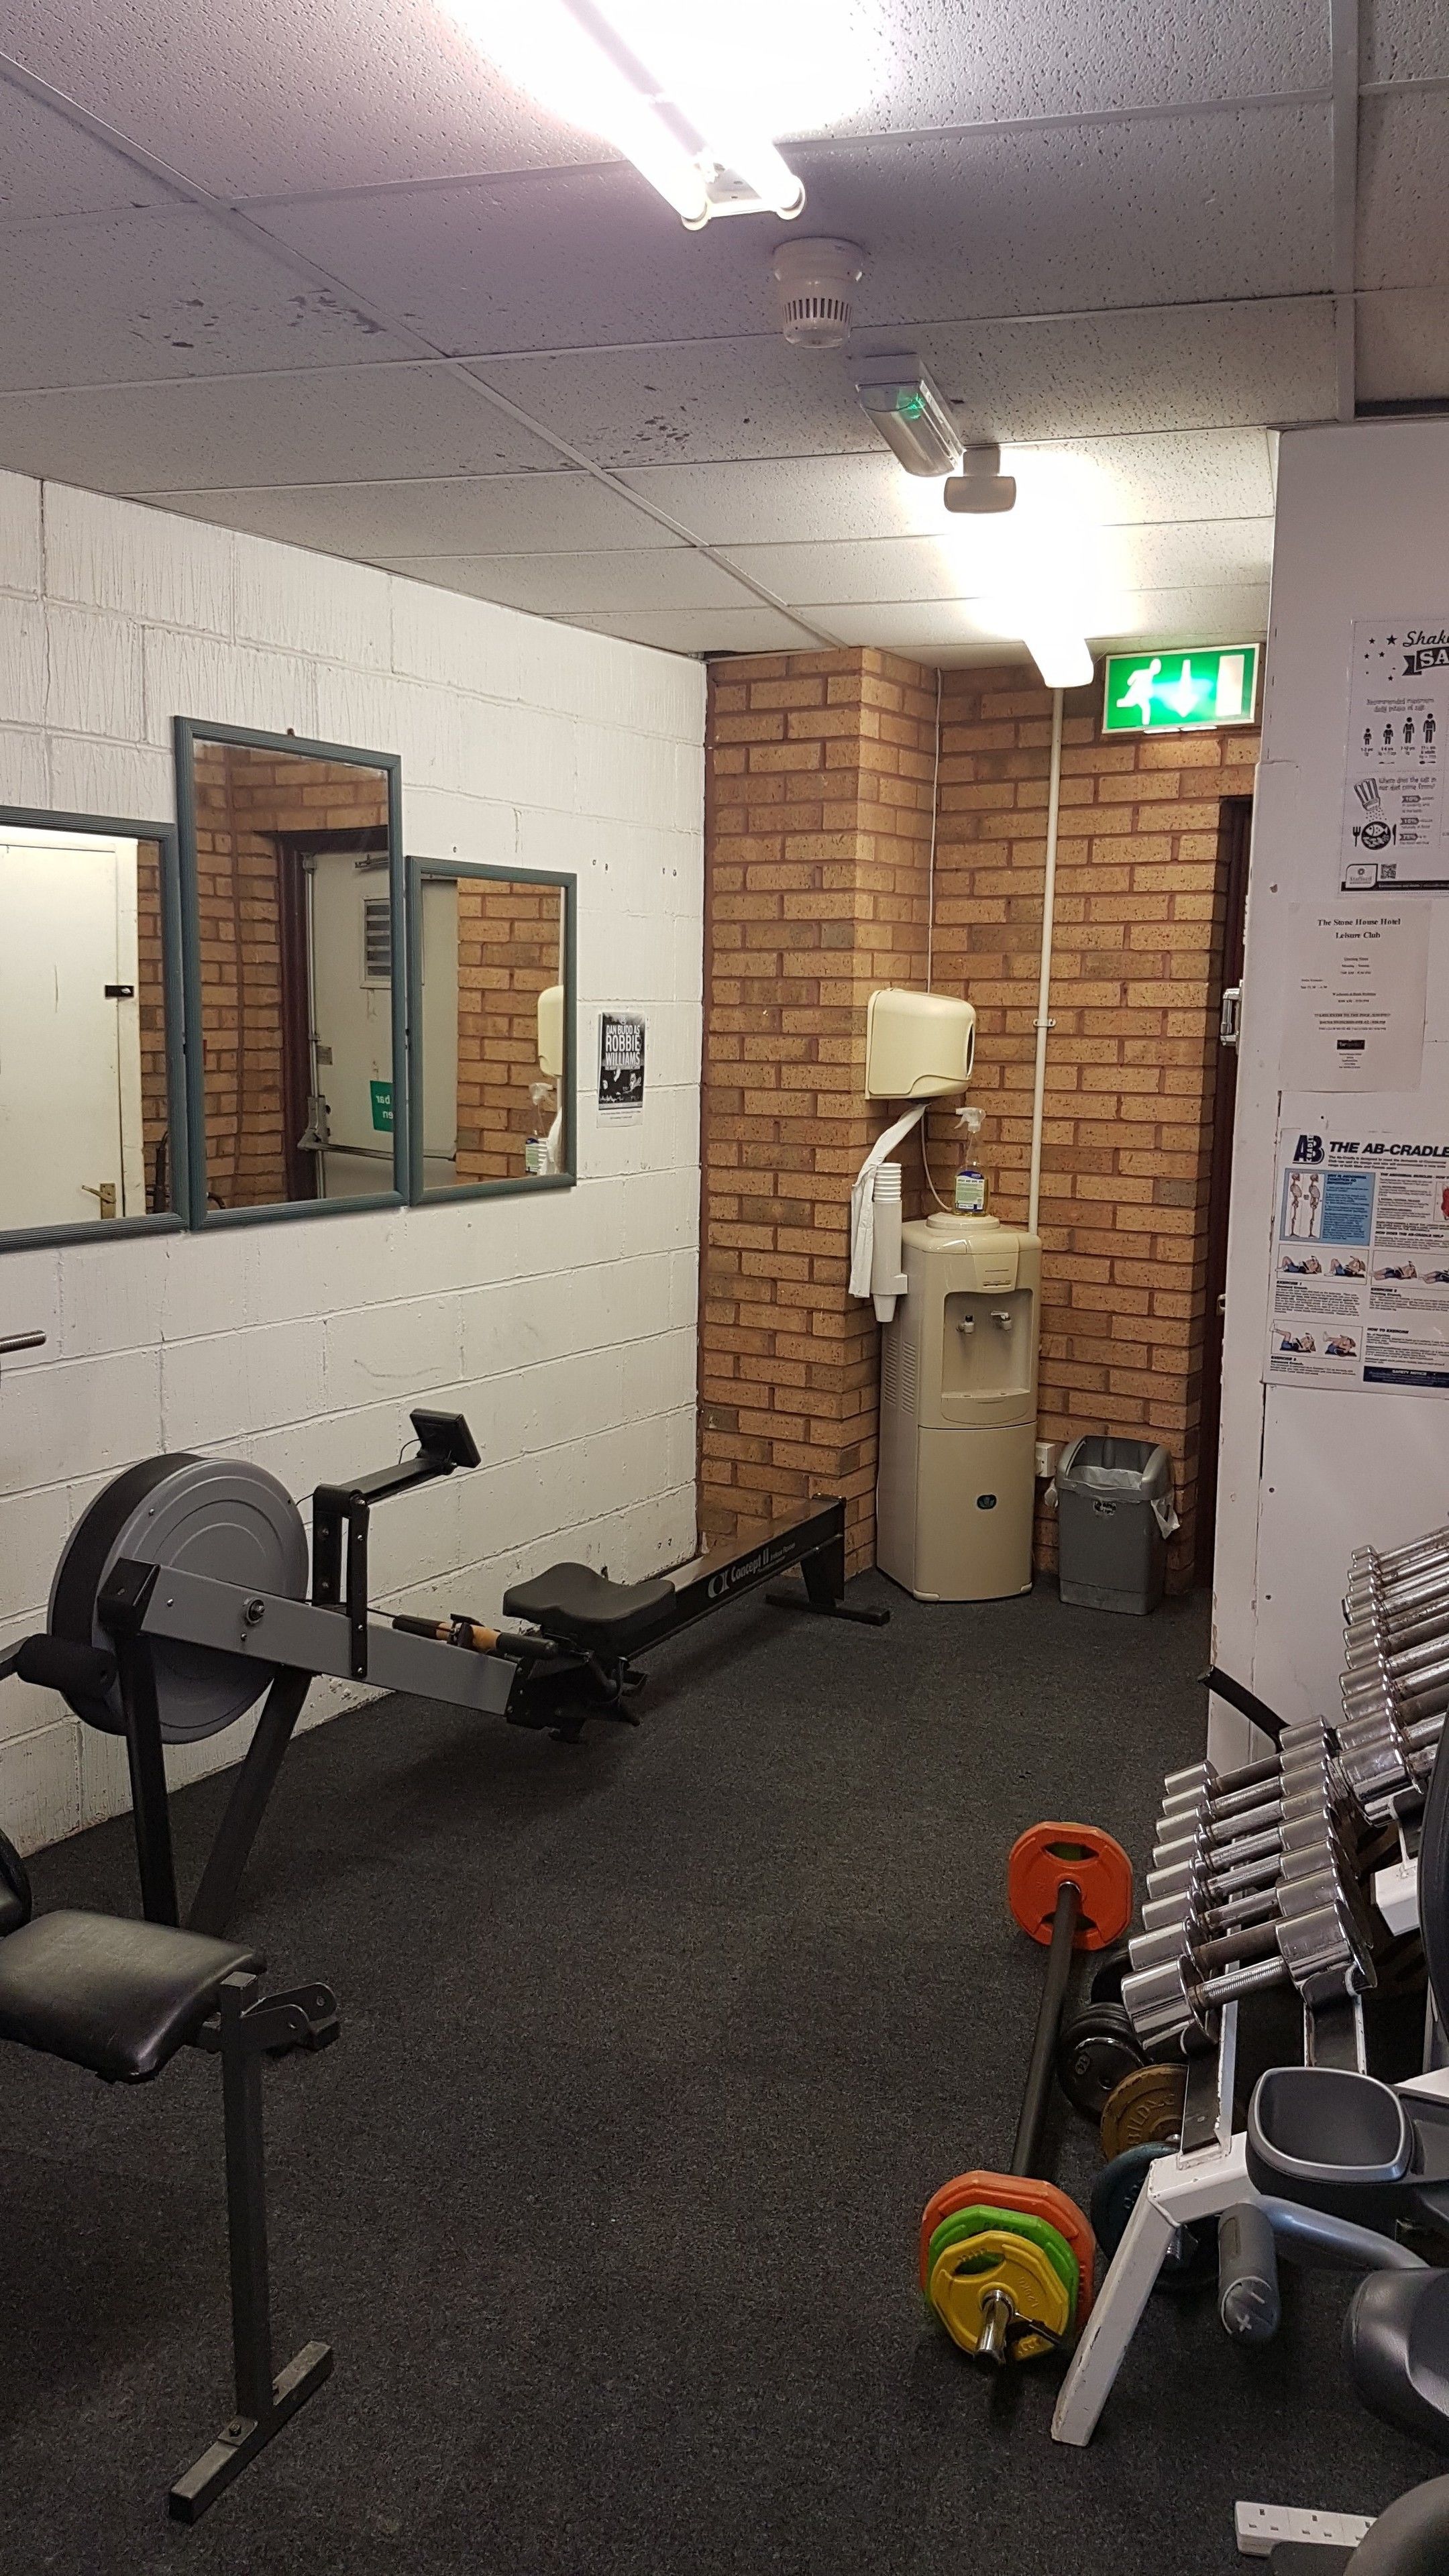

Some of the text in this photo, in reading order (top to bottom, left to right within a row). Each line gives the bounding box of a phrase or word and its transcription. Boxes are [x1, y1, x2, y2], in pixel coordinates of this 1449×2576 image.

[606, 1025, 641, 1035] DAN BUDD AS
[605, 1035, 641, 1052] ROBBIE
[605, 1052, 641, 1066] WILLIAMS
[1330, 1141, 1449, 1158] THE AB-CRADLE
[731, 1554, 761, 1582] Concept
